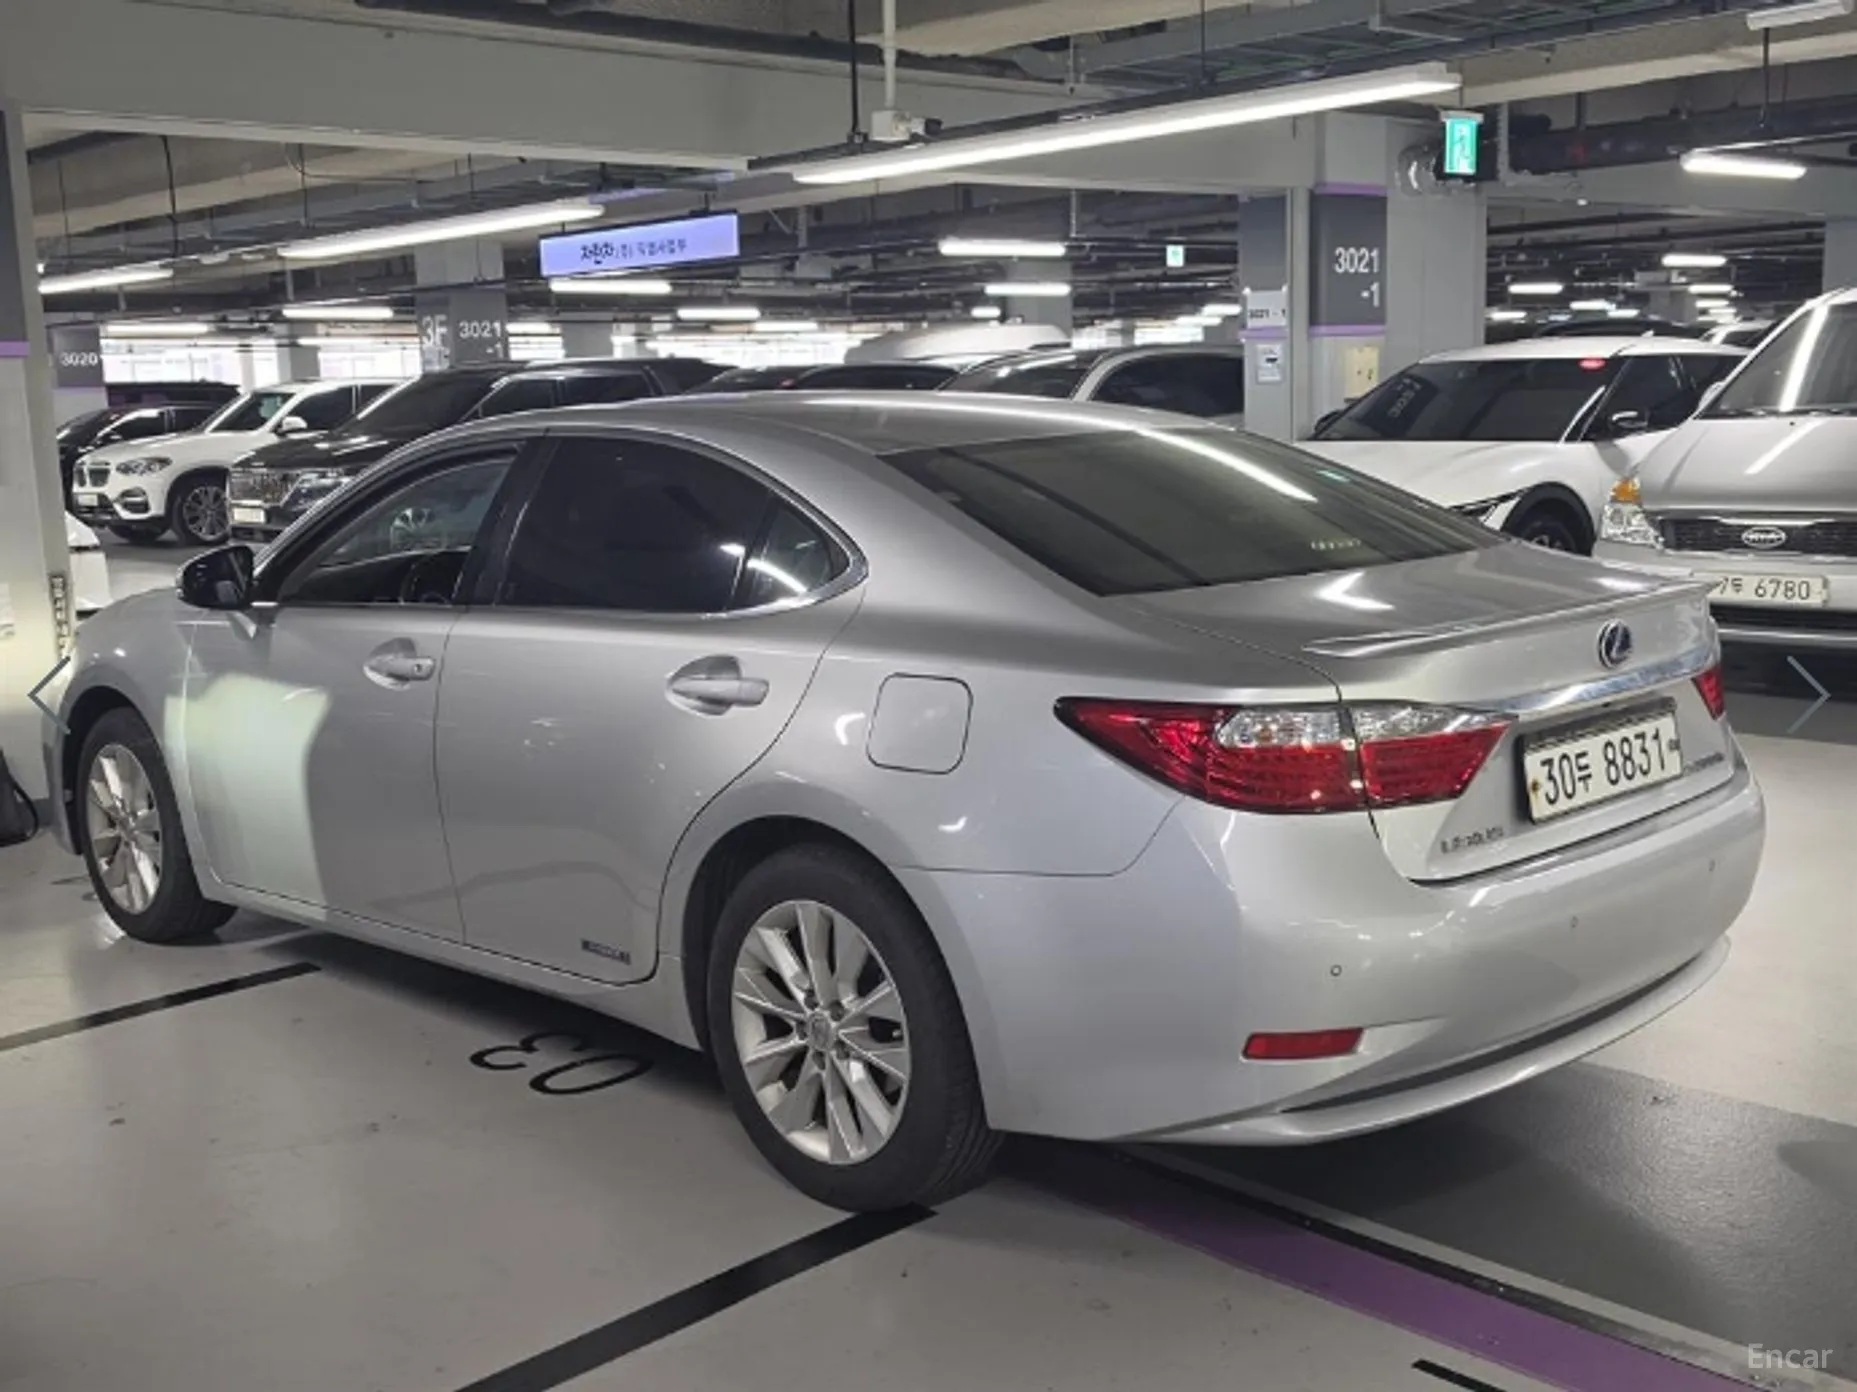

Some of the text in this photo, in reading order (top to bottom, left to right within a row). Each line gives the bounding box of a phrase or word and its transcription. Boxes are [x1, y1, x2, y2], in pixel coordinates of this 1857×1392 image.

[1334, 247, 1379, 273] 3021
[1360, 281, 1380, 307] -1
[422, 315, 448, 347] 3F
[459, 320, 502, 339] 3021
[60, 351, 98, 367] 3020
[1754, 578, 1810, 600] 6780
[1540, 751, 1592, 804] 30두
[1603, 727, 1665, 785] 8831
